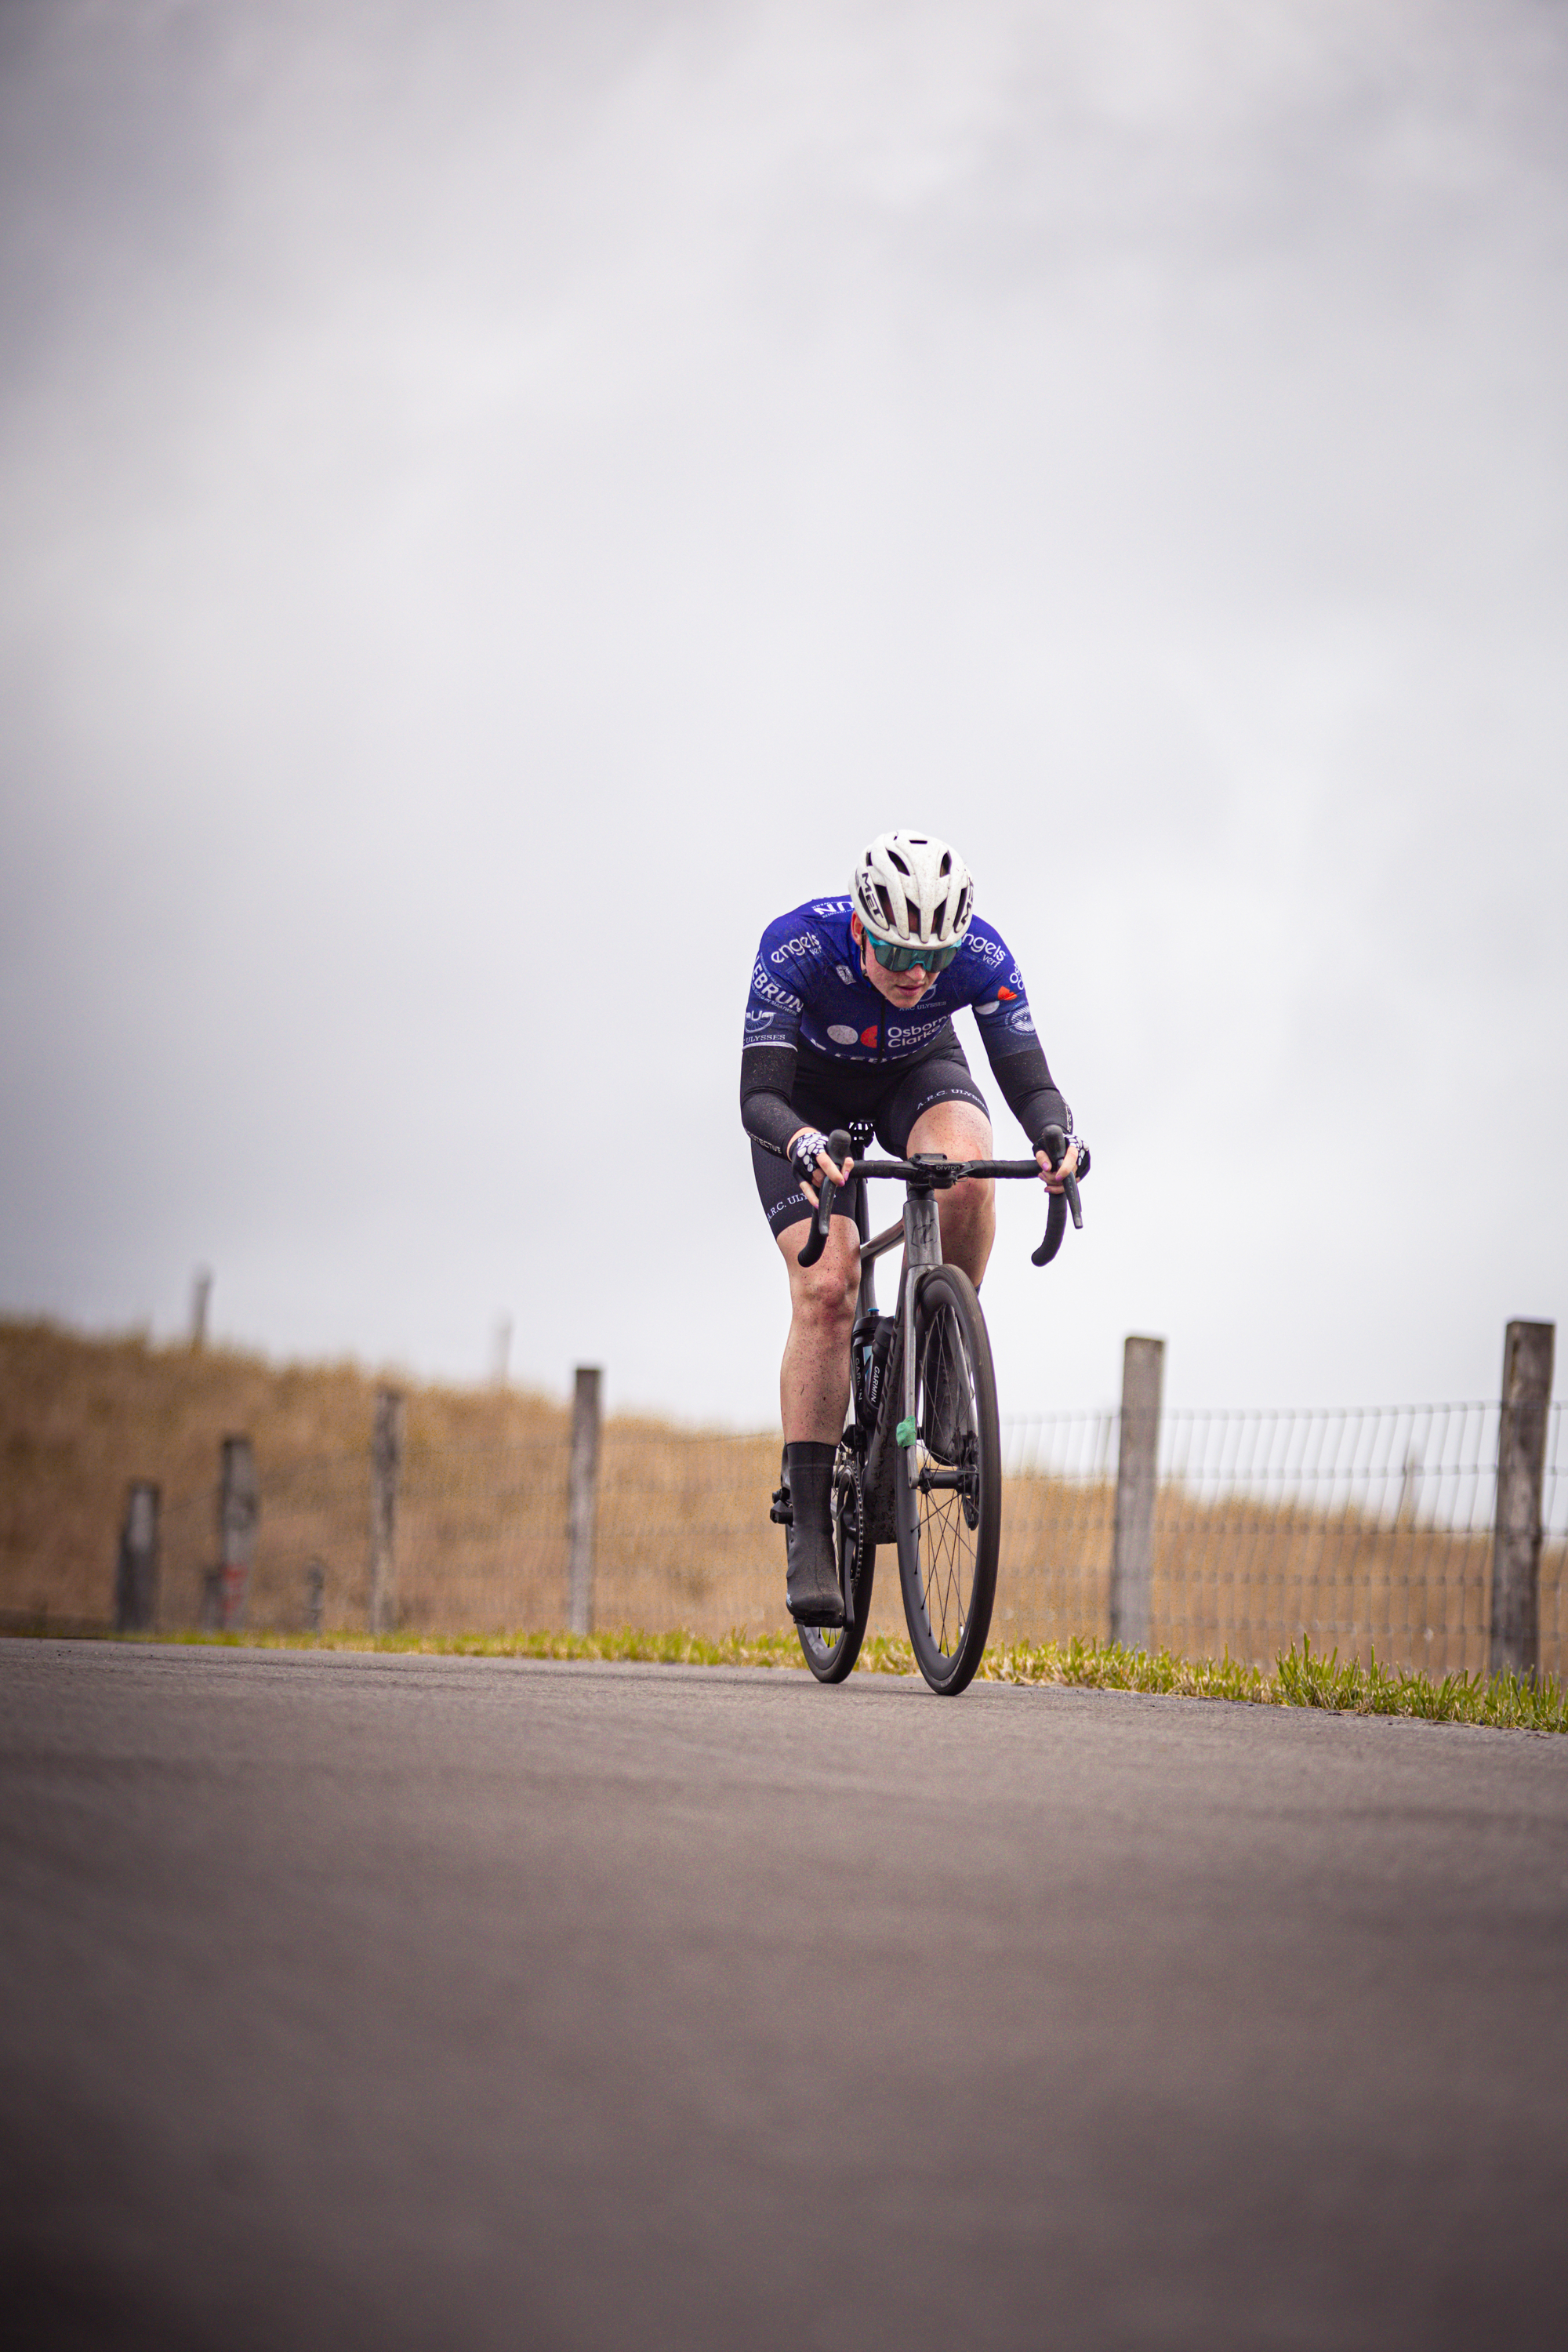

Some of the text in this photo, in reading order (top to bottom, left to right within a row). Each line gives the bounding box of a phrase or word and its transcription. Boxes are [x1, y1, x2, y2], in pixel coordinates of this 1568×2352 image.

[862, 873, 884, 918] MET
[771, 931, 820, 964] engels
[962, 933, 1006, 961] ngels
[982, 954, 1001, 968] verf
[746, 1034, 786, 1044] ULYSSES
[887, 1014, 950, 1038] Osborn
[870, 1366, 880, 1403] GARMIN
